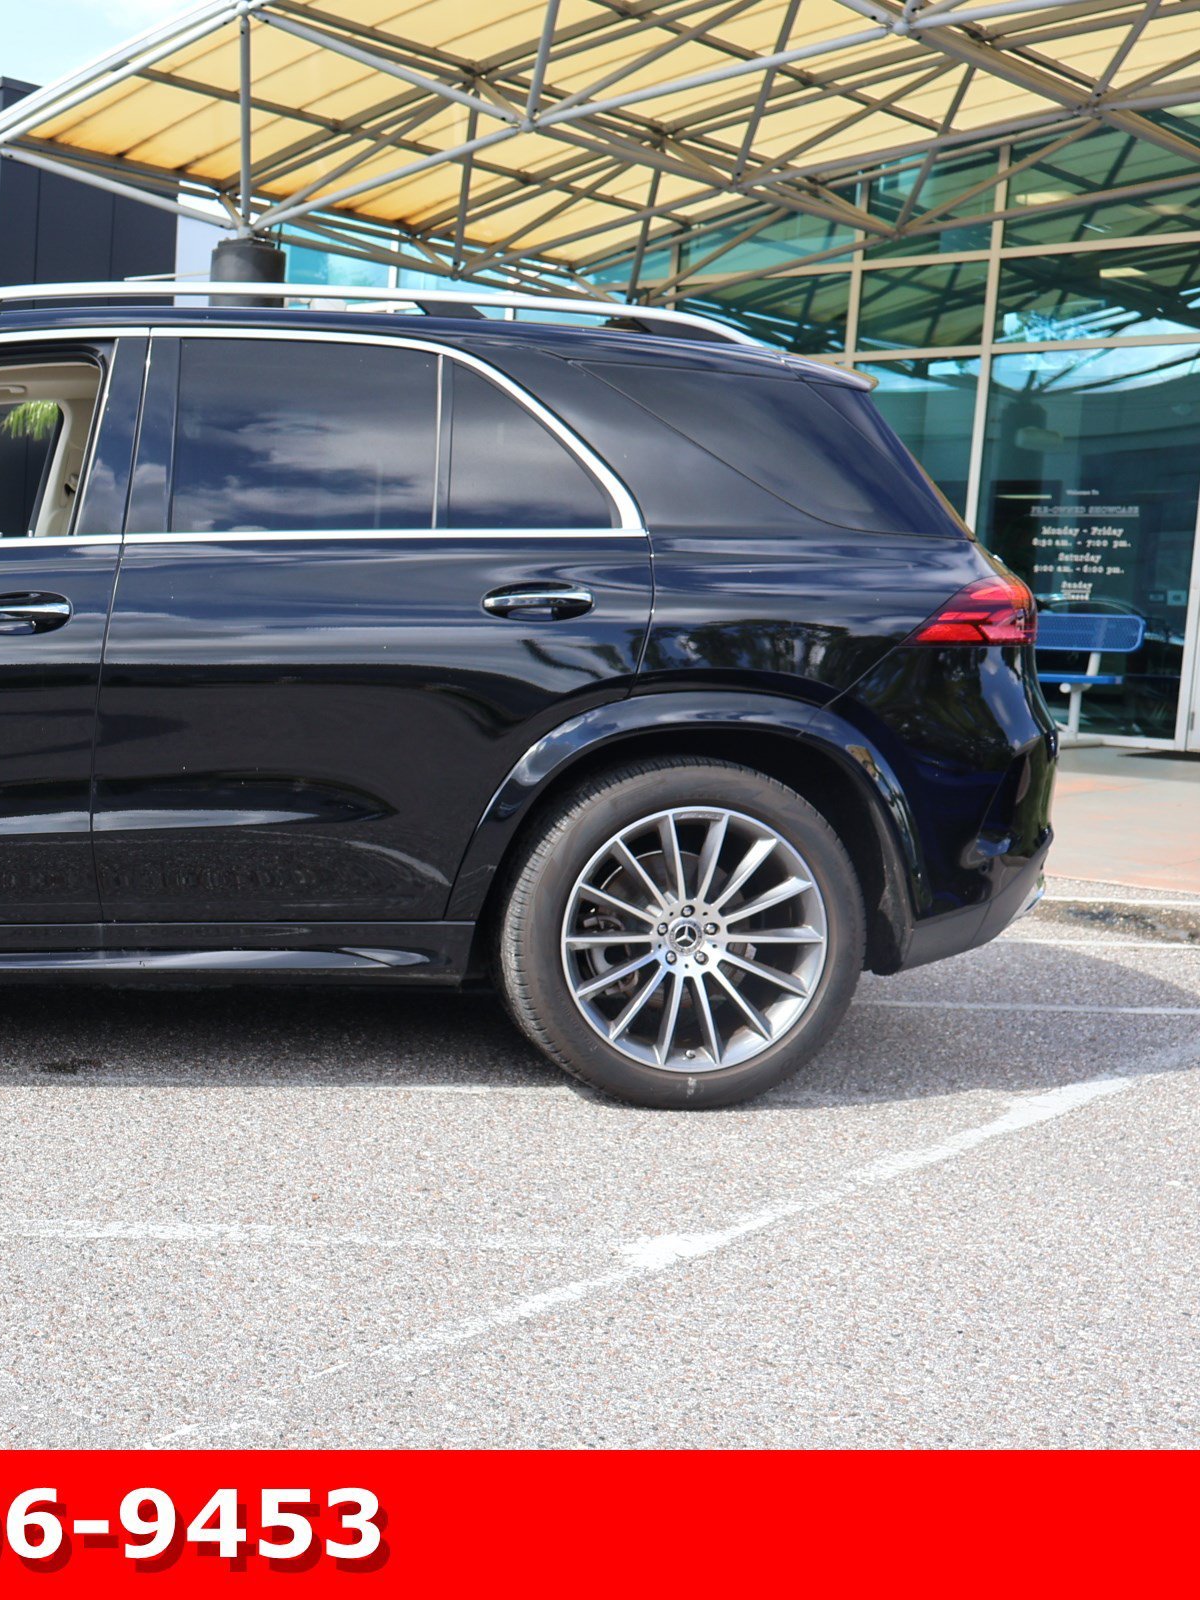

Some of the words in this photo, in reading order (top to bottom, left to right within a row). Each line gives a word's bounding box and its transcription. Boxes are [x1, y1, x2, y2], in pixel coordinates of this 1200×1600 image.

[1041, 526, 1080, 536] Monday
[1091, 527, 1124, 537] Friday
[1058, 552, 1102, 564] Saturday
[1061, 580, 1093, 591] Sunday
